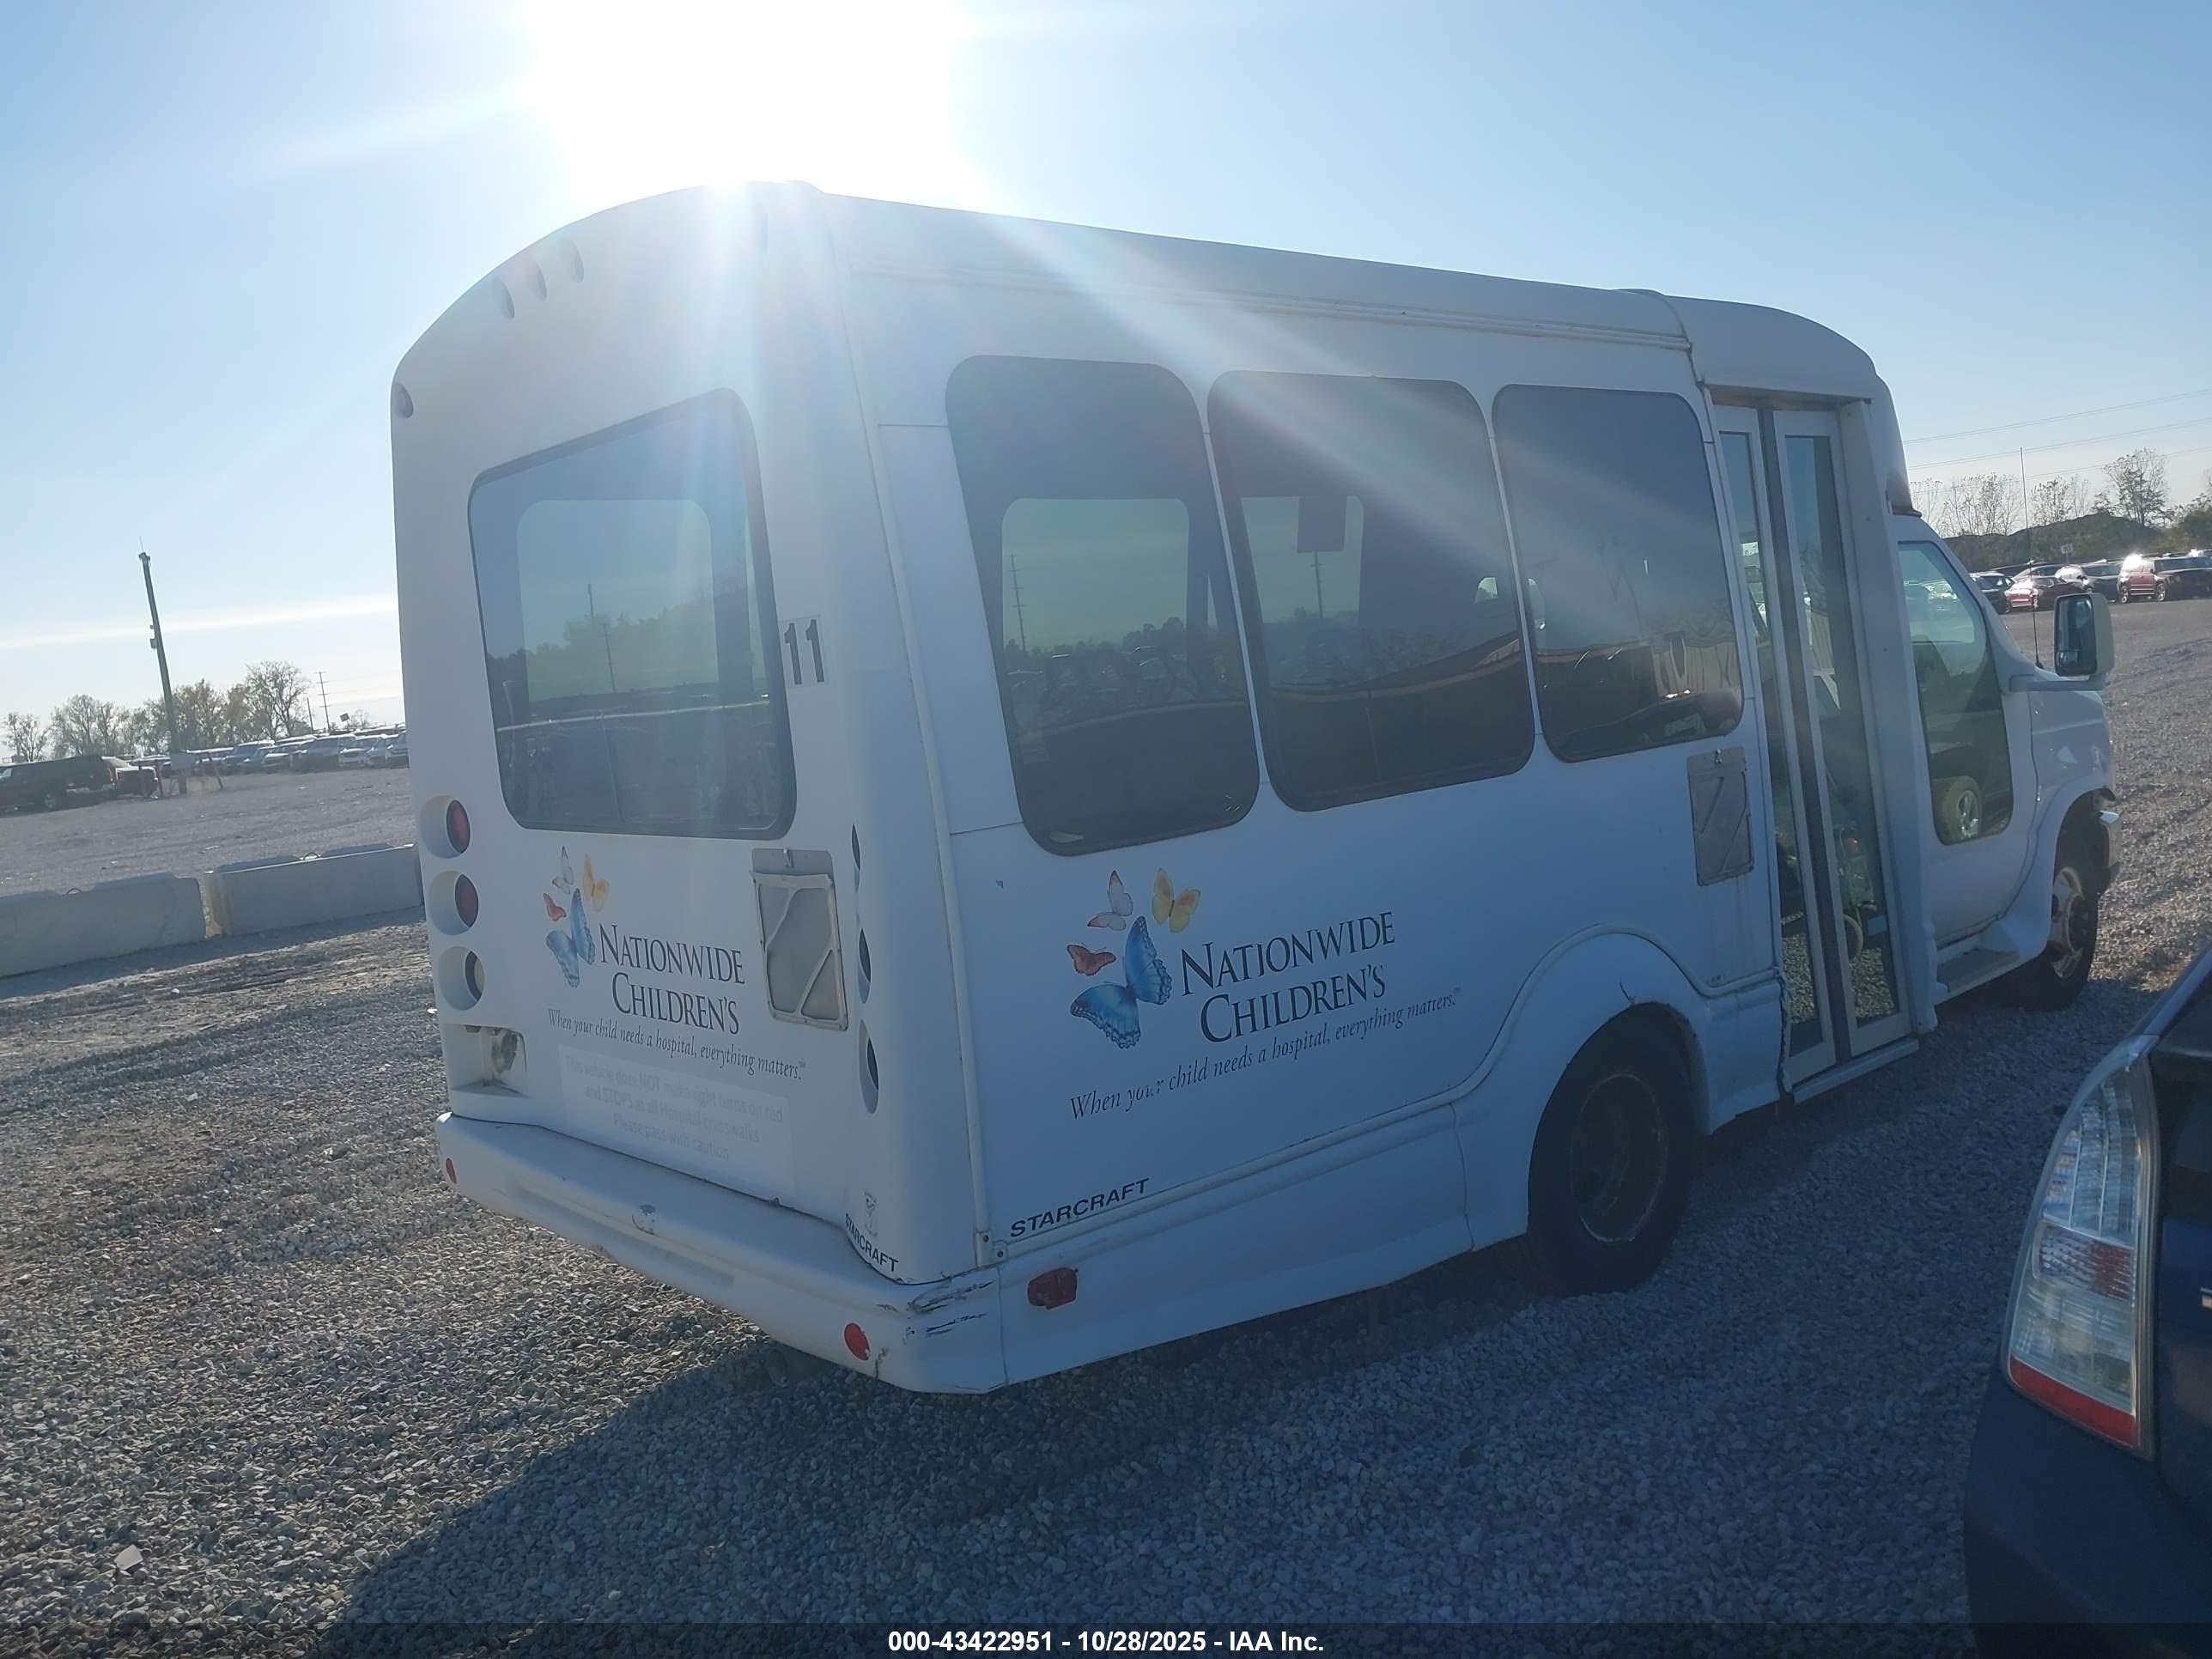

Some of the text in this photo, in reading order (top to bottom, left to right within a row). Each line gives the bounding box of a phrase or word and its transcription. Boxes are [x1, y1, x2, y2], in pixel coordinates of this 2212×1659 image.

[783, 619, 825, 684] 11
[599, 923, 745, 984] NATIONWIDE
[1180, 911, 1395, 996] NATIONWIDE
[611, 972, 739, 1035] CHILDREN'S
[1200, 963, 1387, 1043] CHILDREN'S
[548, 1008, 572, 1030] When
[574, 1018, 593, 1037] your
[595, 1016, 618, 1039] child
[619, 1024, 644, 1045] needs
[646, 1035, 653, 1048] a
[656, 1028, 697, 1059] hospital,
[700, 1043, 755, 1076] everything
[1070, 1090, 1121, 1120] When
[1169, 1056, 1208, 1091] child
[1212, 1044, 1253, 1078] needs
[1257, 1048, 1267, 1064] a
[1271, 1023, 1330, 1060] hospital,
[1335, 1007, 1404, 1041] everything
[585, 1085, 601, 1100] and
[602, 1086, 634, 1109] STOPS
[639, 1072, 660, 1091] NOT
[692, 1085, 716, 1108] right
[718, 1092, 747, 1114] turns
[748, 1103, 762, 1120] on
[764, 1105, 783, 1124] red
[613, 1111, 729, 1161] Please pass with caution
[1010, 1178, 1151, 1237] STARCRAFT
[845, 1212, 899, 1273] STARCRAFT
